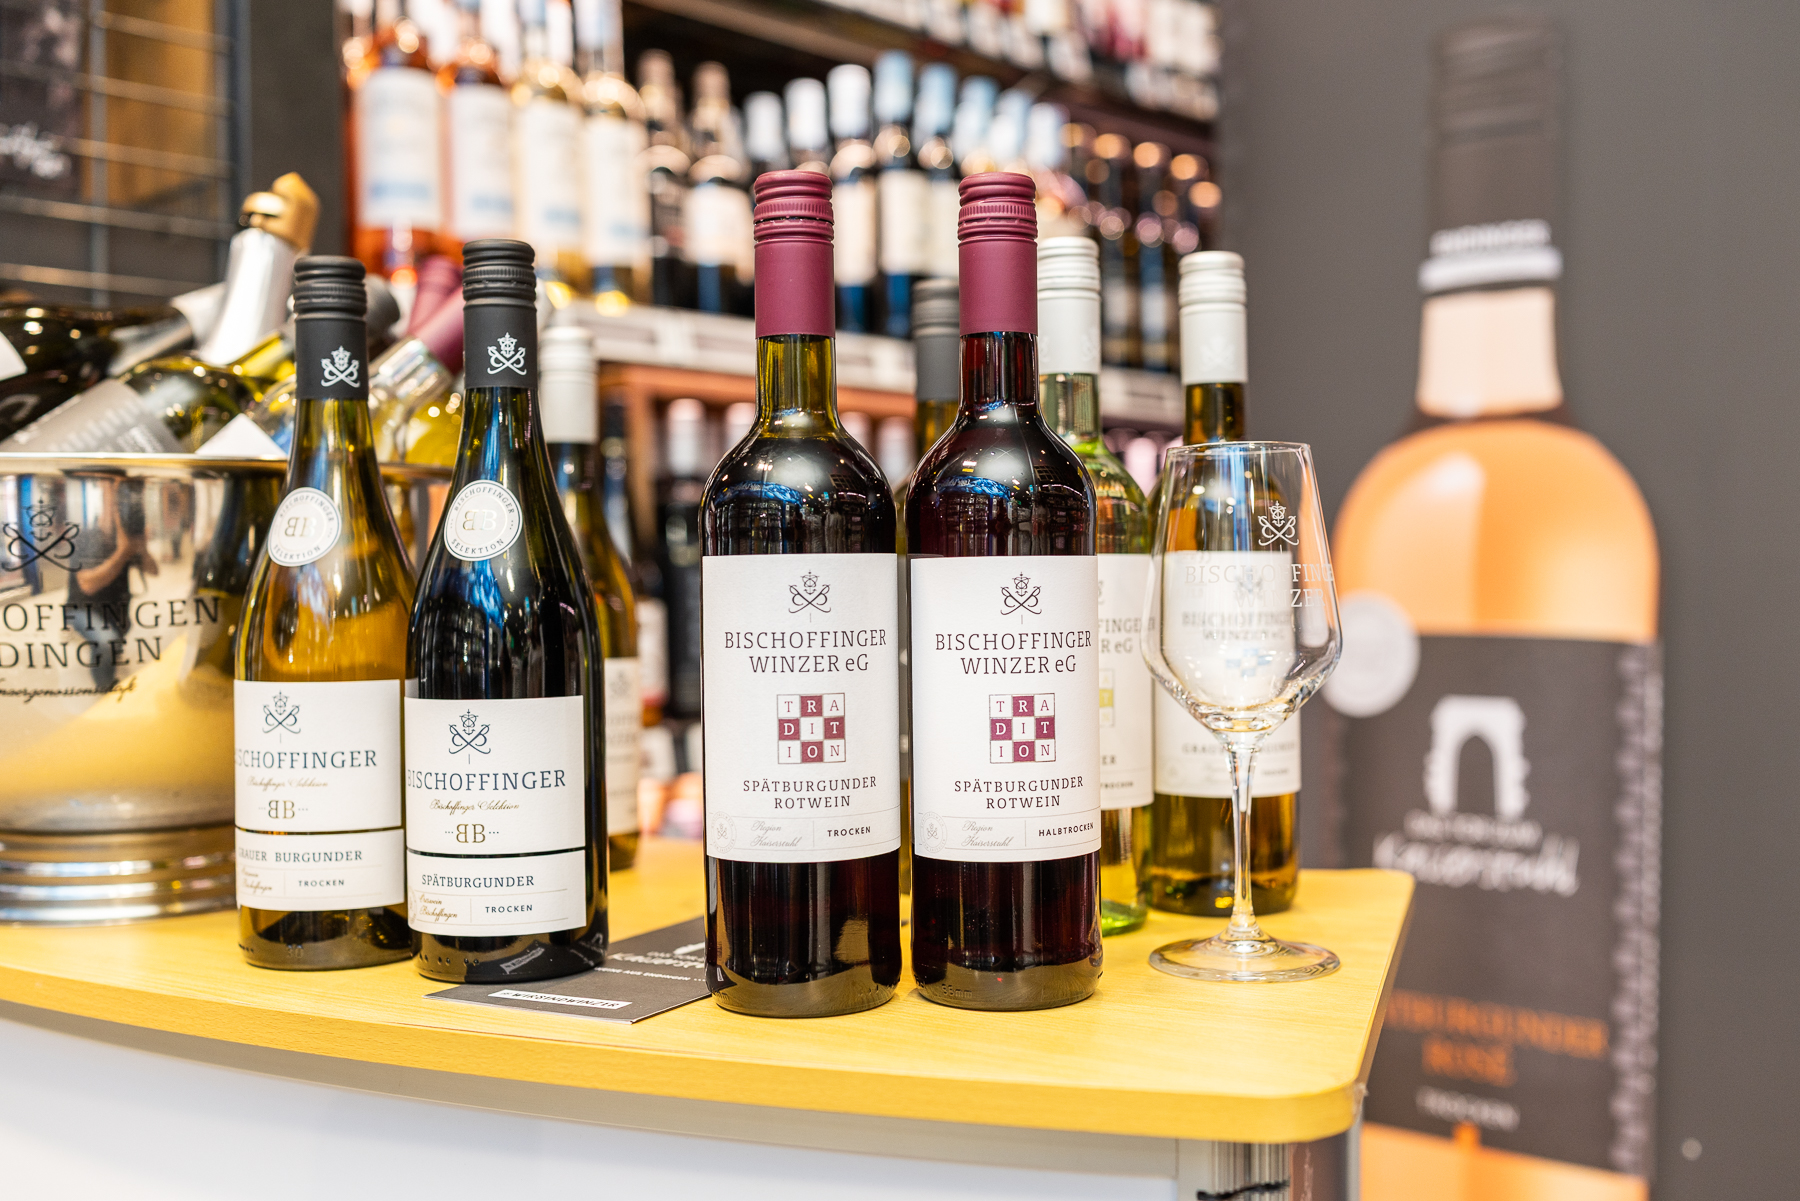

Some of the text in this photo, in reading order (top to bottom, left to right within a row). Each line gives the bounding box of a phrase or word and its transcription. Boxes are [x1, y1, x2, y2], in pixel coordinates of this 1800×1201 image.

[455, 486, 514, 514] BISCHOFFINGER
[451, 539, 504, 554] SELEKTION
[724, 628, 887, 650] BISCHOFFINGER
[935, 630, 1091, 651] BISCHOFFINGER
[749, 653, 869, 674] WINZER eG
[960, 654, 1076, 675] WINZER eG
[236, 750, 377, 769] SCHOFFINGER
[407, 769, 566, 791] BISCHOFFINGER
[743, 776, 877, 793] SPÄTBURGUNDER
[954, 776, 1084, 793] SPÄTBURGUNDER
[774, 794, 851, 810] ROTWEIN
[986, 794, 1061, 810] ROTWEIN
[751, 820, 871, 838] Region TROCKEN
[961, 820, 1094, 838] Region HALBTROCKEN
[275, 850, 363, 863] BURGUNDER
[298, 879, 345, 887] TROCKEN
[421, 873, 535, 889] SPÄTBURGUNDER
[485, 904, 533, 914] TROCKEN
